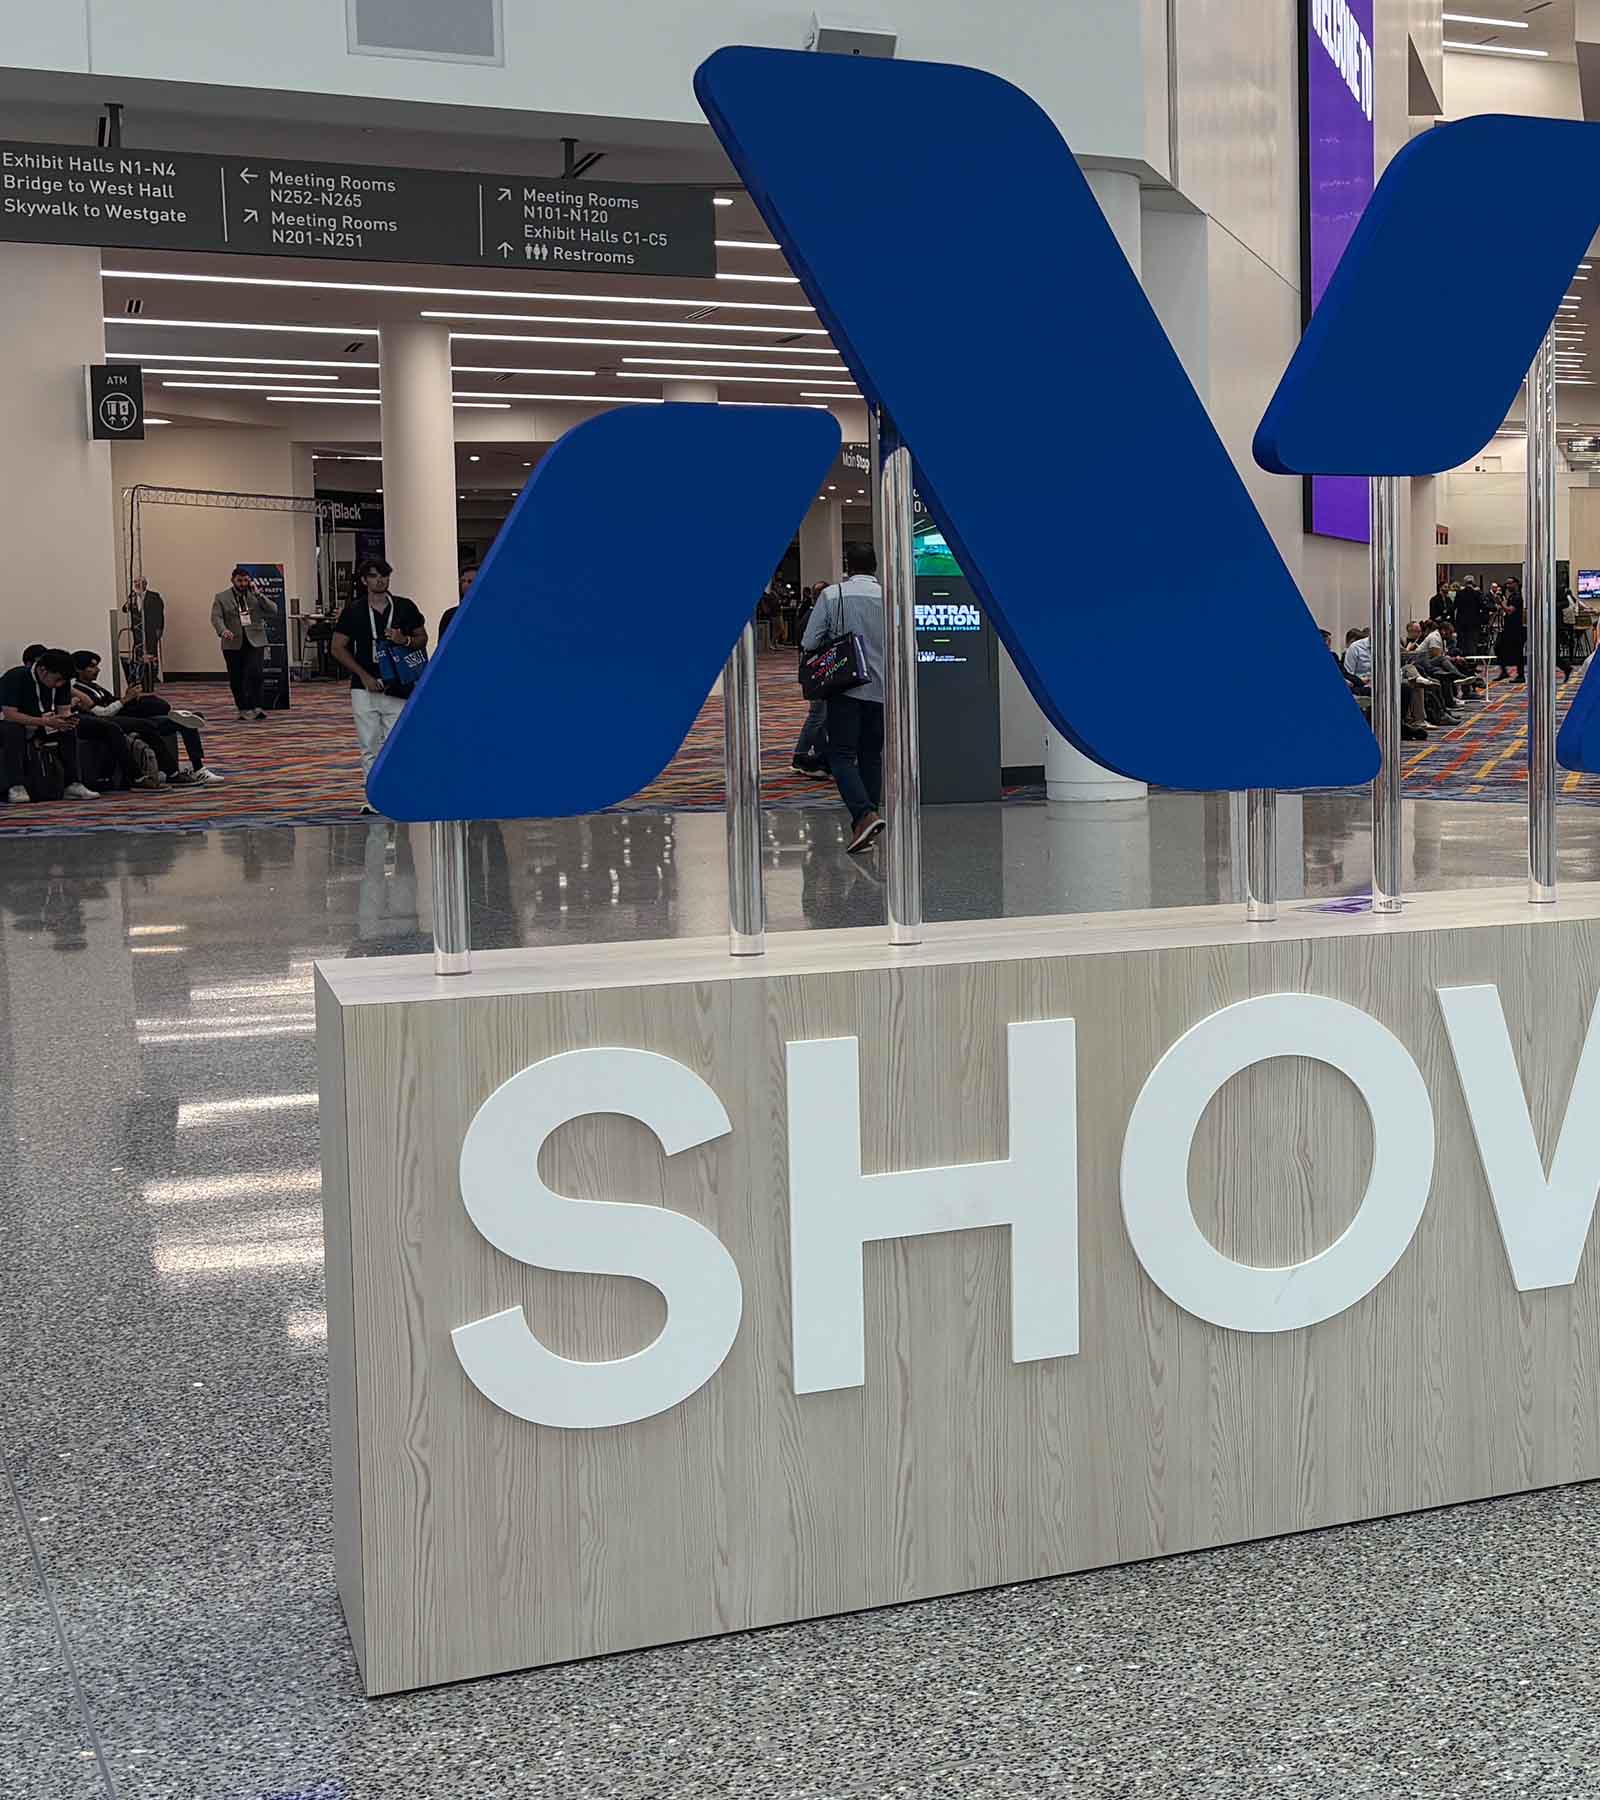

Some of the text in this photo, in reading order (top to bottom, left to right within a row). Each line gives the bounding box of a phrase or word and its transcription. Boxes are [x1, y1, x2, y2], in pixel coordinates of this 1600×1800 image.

[1360, 31, 1372, 122] TO
[3, 152, 176, 177] Exhibit Halls N1-N4
[4, 175, 175, 198] Bridge to West Hall
[269, 170, 396, 192] Meeting Rooms
[270, 189, 362, 208] N252-N265
[523, 188, 640, 209] Meeting Rooms
[4, 199, 187, 224] Skywalk to Westgate
[271, 211, 398, 232] Meeting Rooms
[524, 206, 609, 223] N101-N120
[272, 229, 363, 248] N201-N251
[524, 224, 668, 247] Exhibit Halls C1-C5
[553, 247, 635, 264] Restrooms
[106, 375, 128, 385] ATM
[856, 453, 871, 475] Stag
[335, 503, 361, 520] Black
[914, 604, 980, 615] ENTRAL
[914, 614, 981, 626] TATION
